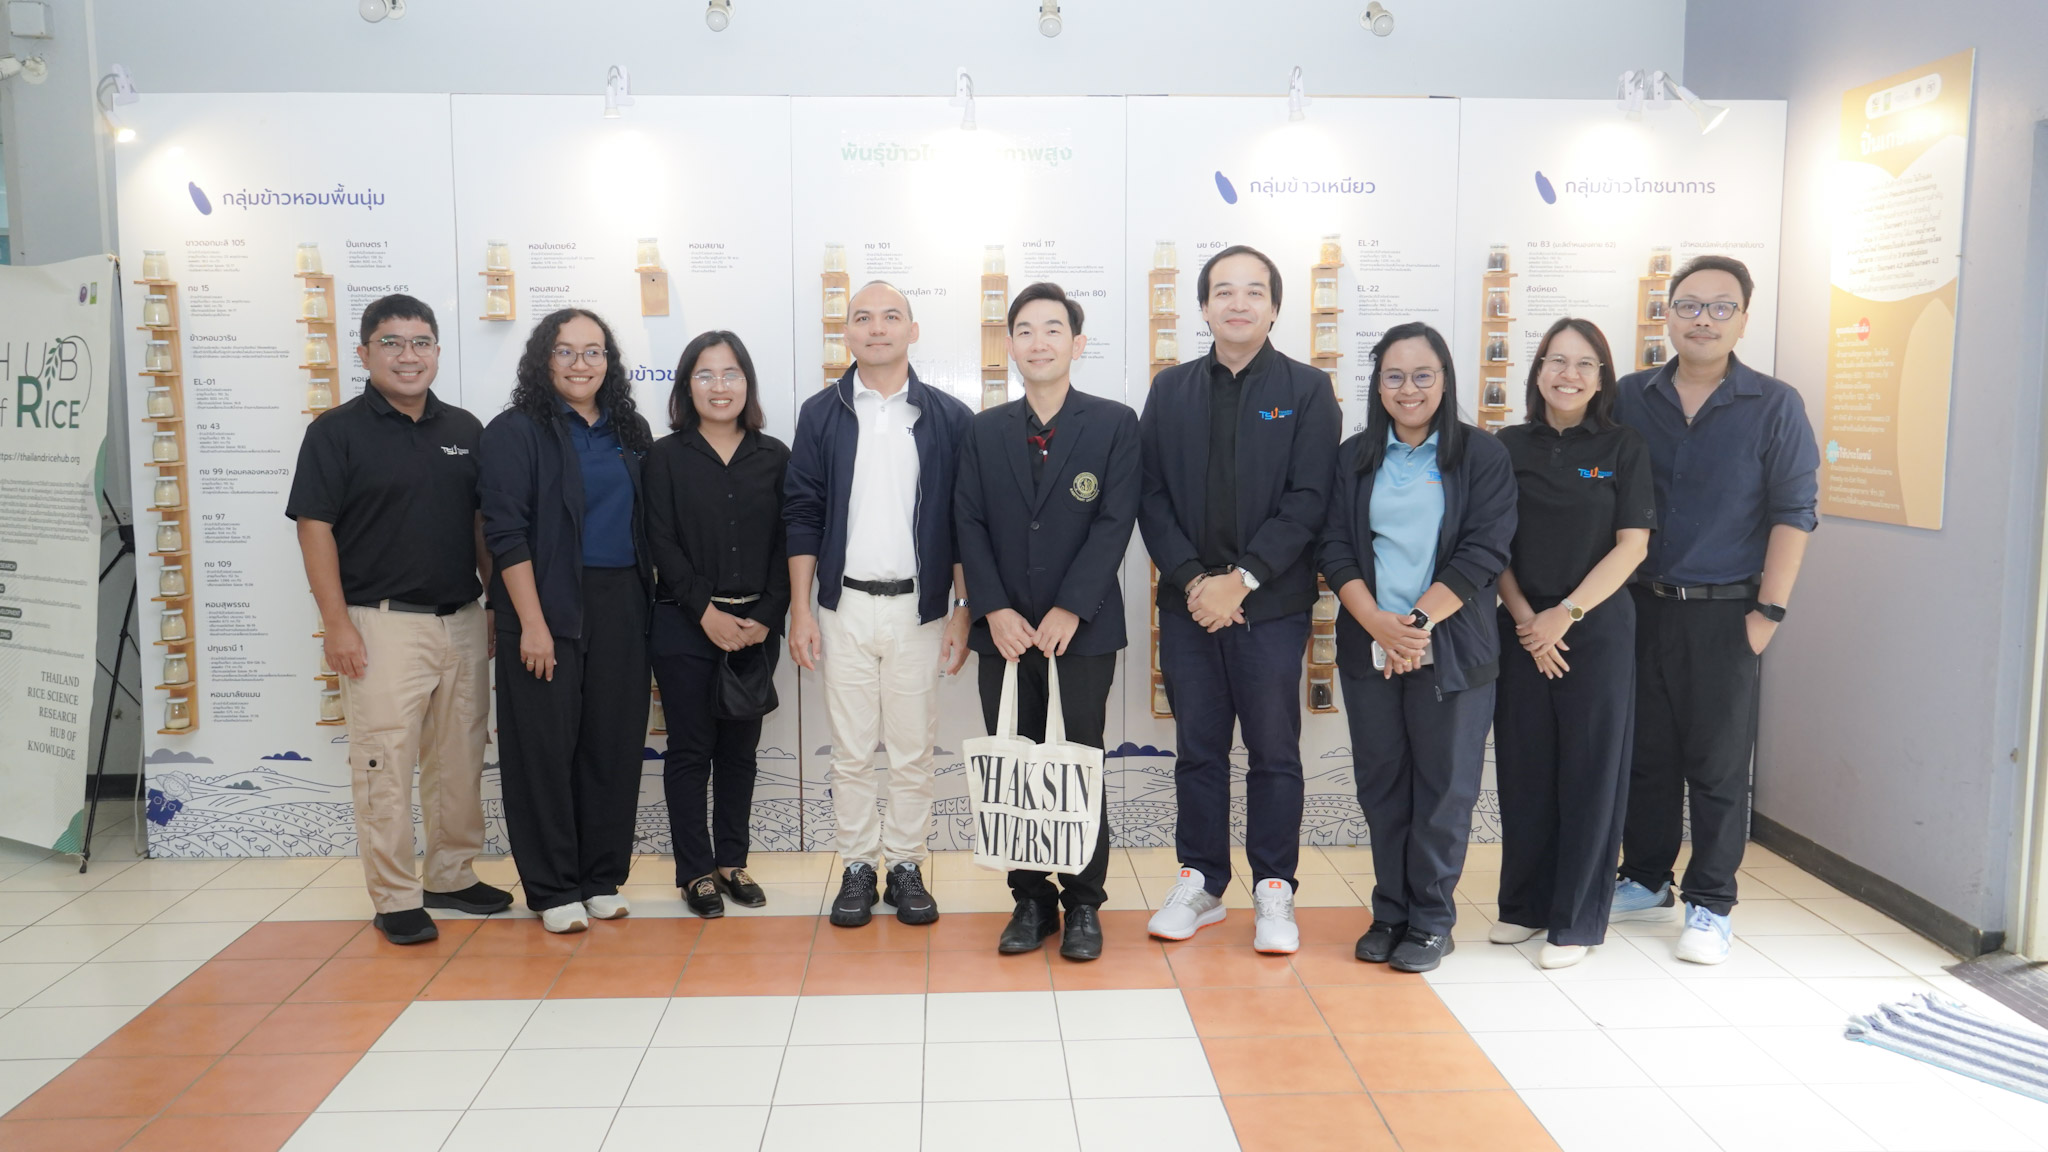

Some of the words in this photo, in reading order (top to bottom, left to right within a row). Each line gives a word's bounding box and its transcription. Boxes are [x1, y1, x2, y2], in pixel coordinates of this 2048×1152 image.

[1249, 176, 1376, 198] กลุ่มข้าวเหนียว
[1565, 177, 1717, 198] กลุ่มข้าวโภชนาการ
[222, 183, 386, 211] กลุ่มข้าวหอมพื้นนุ่ม
[231, 239, 246, 247] 105
[383, 240, 388, 248] 1
[688, 241, 725, 250] หอมสยาม
[878, 241, 891, 250] 101
[1044, 240, 1056, 248] 117
[1210, 241, 1228, 249] 60-1
[1358, 239, 1380, 247] EL-21
[1540, 240, 1551, 249] 83
[201, 284, 210, 293] 15
[393, 284, 410, 293] 6F5
[529, 285, 571, 293] หอมสยาม2
[934, 288, 947, 298] 72)
[1357, 284, 1380, 293] EL-22
[1092, 290, 1107, 298] 80)
[190, 333, 237, 342] ข้าวหอมวาริน
[193, 378, 216, 386] EL-01
[17, 376, 81, 428] RICE
[1258, 406, 1279, 421] TSU
[210, 422, 221, 430] 43
[212, 467, 224, 476] 99
[1577, 466, 1599, 479] TSU
[215, 513, 226, 521] 97
[217, 560, 232, 568] 109
[205, 601, 251, 610] หอมสุพรรณ
[239, 644, 244, 652] 1
[41, 671, 80, 688] THAILAND
[27, 687, 46, 700] RICE
[47, 690, 79, 706] SCIENCE
[39, 706, 77, 724] RESEARCH
[50, 726, 66, 740] HUB
[67, 729, 77, 742] OF
[27, 740, 76, 760] KNOWLEDGE
[970, 754, 1092, 814] THAKSIN
[974, 811, 1090, 867] NIVERSITY
